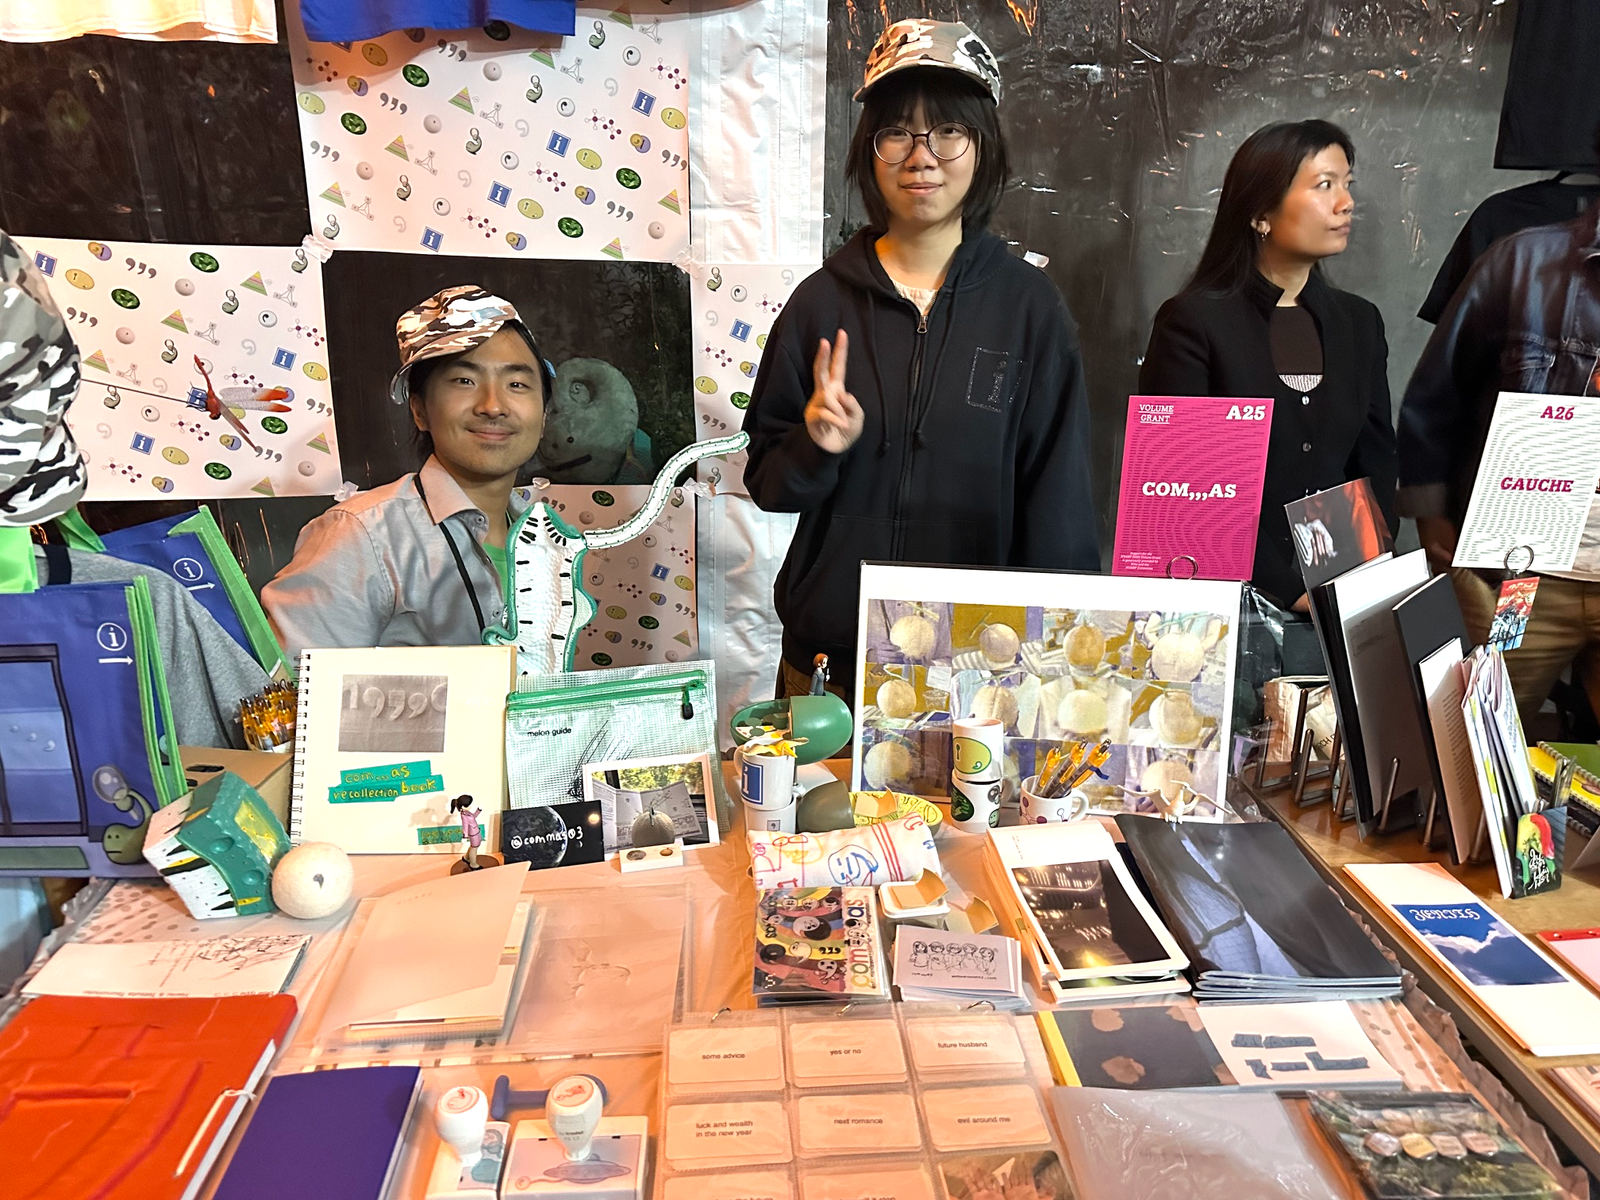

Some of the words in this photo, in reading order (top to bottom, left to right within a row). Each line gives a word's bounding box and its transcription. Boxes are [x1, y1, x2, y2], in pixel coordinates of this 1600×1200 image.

[1139, 404, 1174, 413] VOLUME
[1226, 405, 1266, 421] A25
[1540, 405, 1575, 420] A26
[1140, 414, 1171, 423] GRANT
[1500, 477, 1574, 493] GAUCHE
[1142, 482, 1237, 501] COM,,,AS
[527, 729, 550, 737] melon
[552, 727, 572, 736] guide
[333, 787, 399, 800] recollection
[401, 778, 436, 793] book
[696, 1121, 711, 1129] luck
[730, 1120, 753, 1128] wealth
[736, 1129, 752, 1137] year
